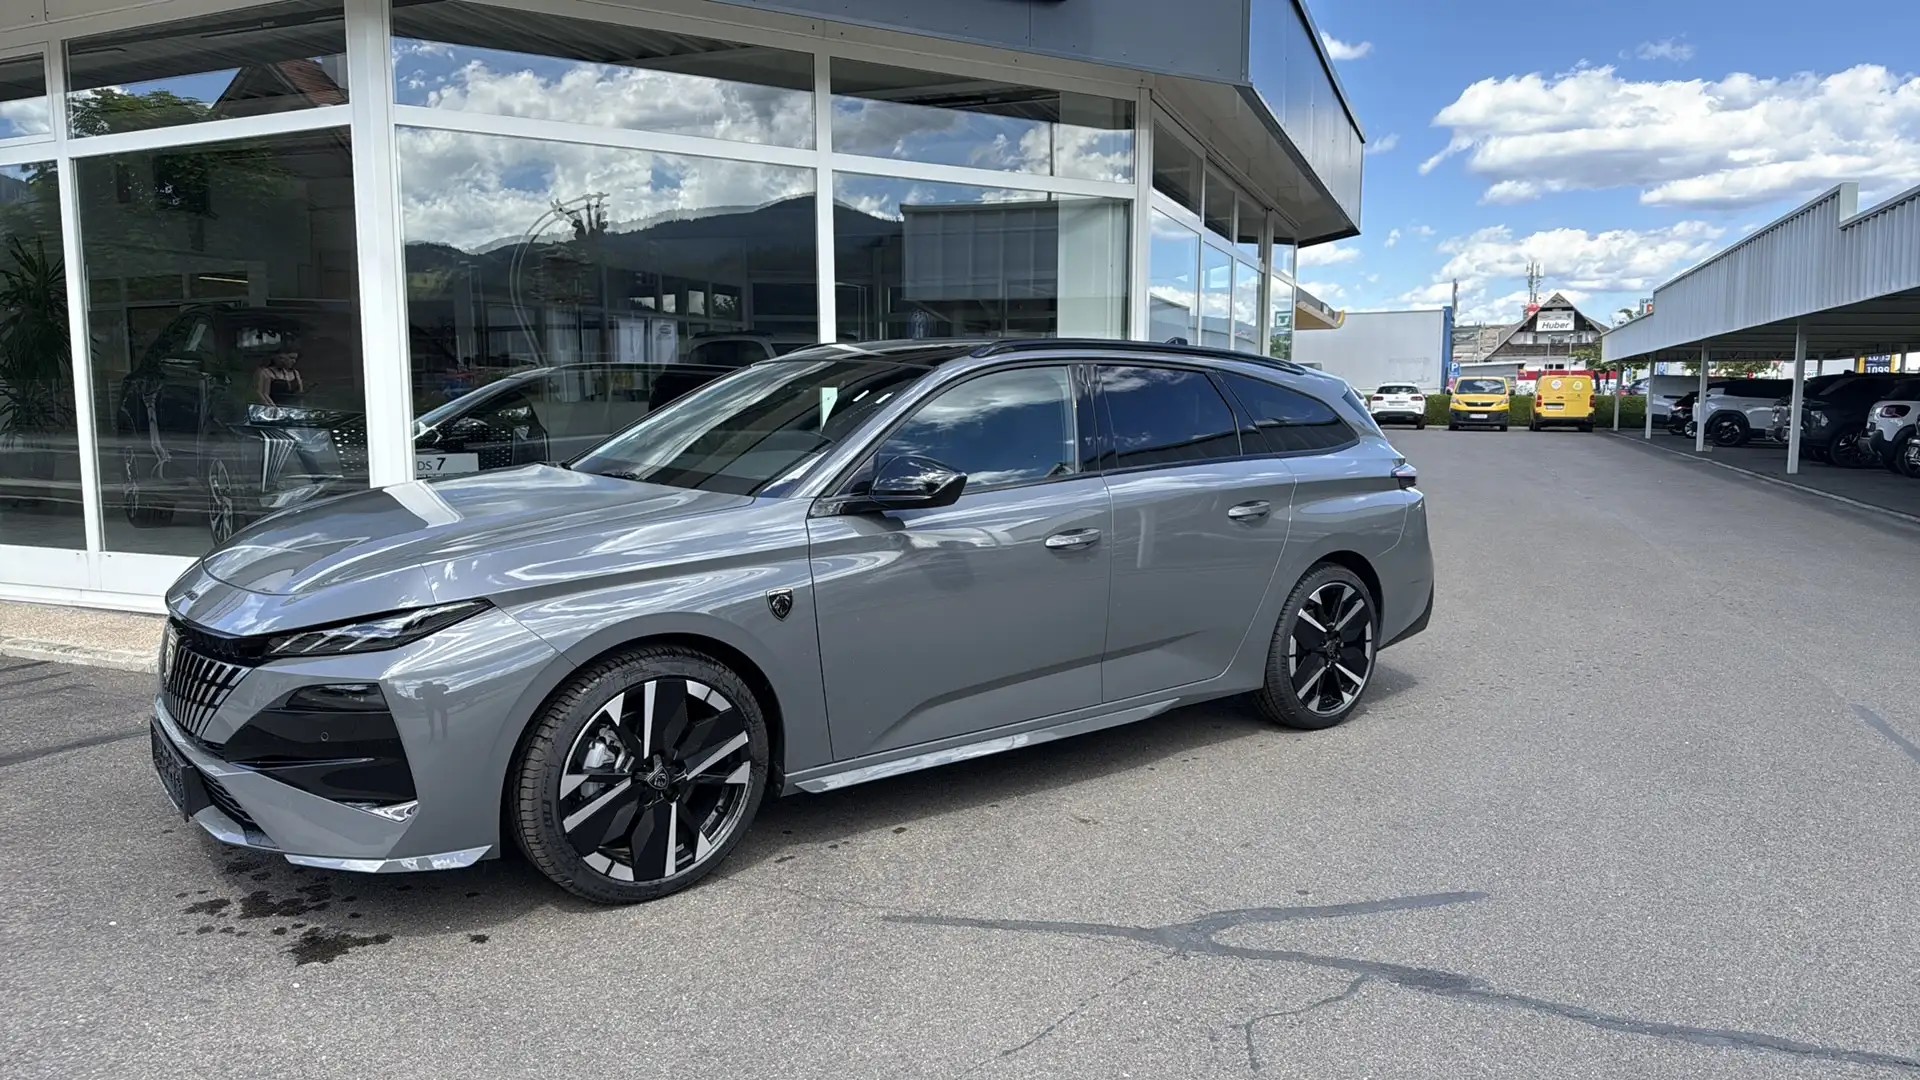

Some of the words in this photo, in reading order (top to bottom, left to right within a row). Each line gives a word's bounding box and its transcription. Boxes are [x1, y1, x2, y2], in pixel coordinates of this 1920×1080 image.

[1541, 321, 1570, 329] Huber
[1451, 362, 1459, 371] P
[417, 461, 432, 470] DS
[436, 457, 446, 470] 7
